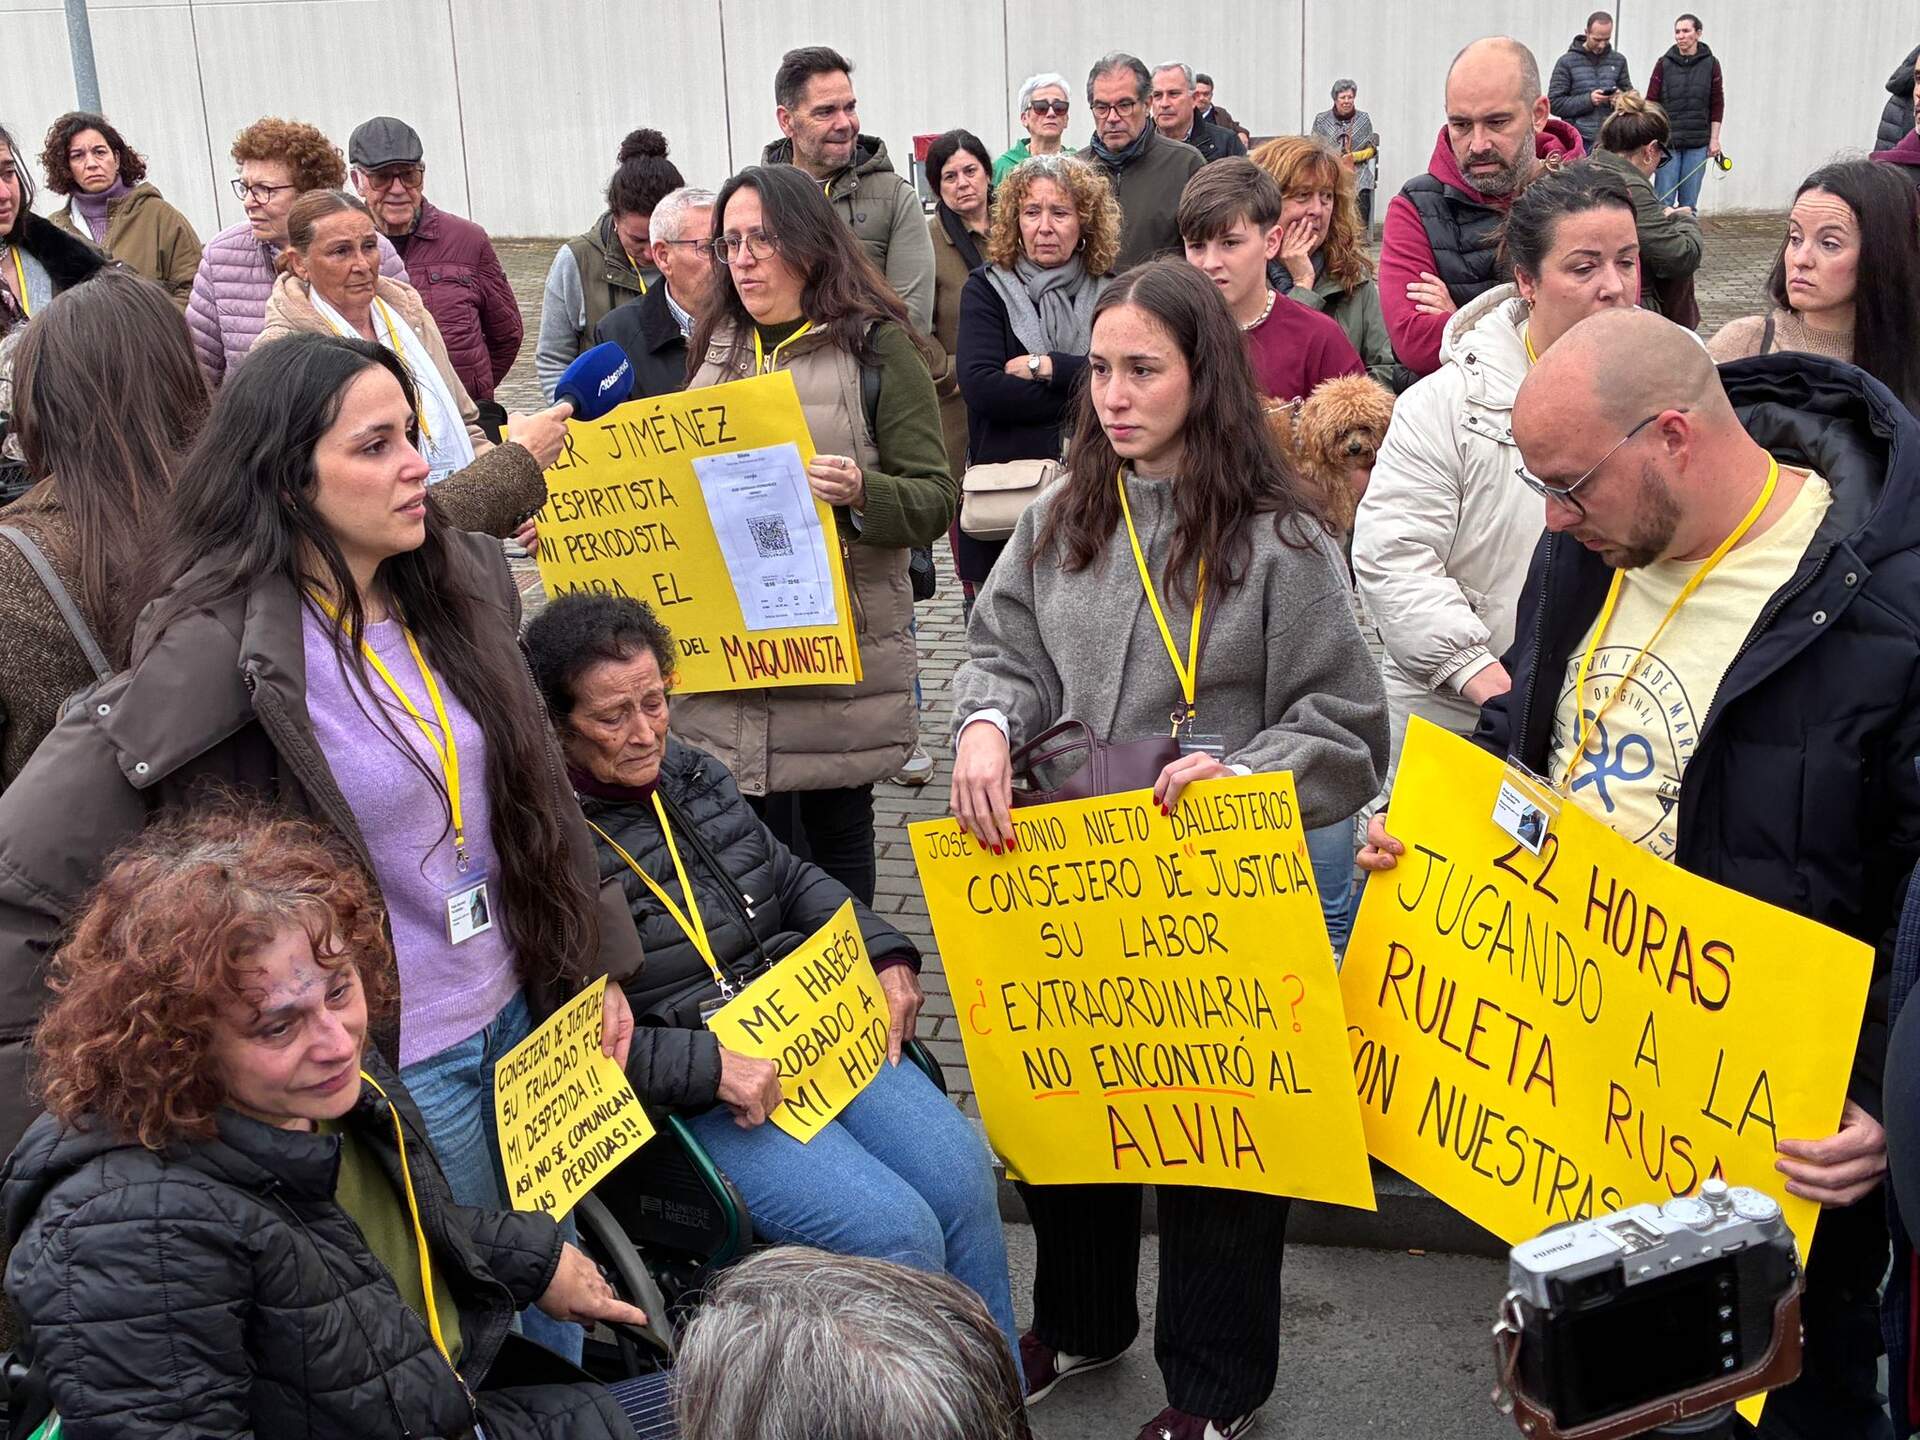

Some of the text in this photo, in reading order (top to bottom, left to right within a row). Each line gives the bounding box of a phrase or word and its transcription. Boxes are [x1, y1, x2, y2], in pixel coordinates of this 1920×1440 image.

[600, 404, 736, 459] JIMÉNEZ
[550, 477, 679, 522] ESPIRITISTA
[539, 523, 681, 564] NI PERIODISTA
[652, 572, 693, 606] EL
[679, 635, 848, 682] DEL MAQUINISTA
[989, 817, 1067, 857] TONIO
[1083, 806, 1149, 848] NIETO
[1170, 790, 1292, 841] BALLESTEROS
[967, 857, 1141, 915] CONSEJERO
[1155, 852, 1192, 898] DE
[1040, 912, 1228, 959] SU LABOR
[1493, 832, 1735, 1011] 22 HORAS
[737, 930, 859, 1045] ME HABÉIS
[1397, 844, 1778, 1154] JUGANDO A LA
[498, 1029, 550, 1093] CONSEJERO
[554, 1018, 563, 1049] DE
[771, 984, 876, 1084] ROBADO A
[1378, 940, 1557, 1107] RULETA
[503, 1022, 602, 1126] SU FRIALDAD FUE
[784, 1017, 889, 1127] MI HIJO
[1022, 1035, 1312, 1095] NO ENCONTRÓ AL
[507, 1134, 522, 1166] MI
[516, 1086, 634, 1198] ASÍ NO SE COMUNICAN
[1109, 1103, 1265, 1173] ALVIA
